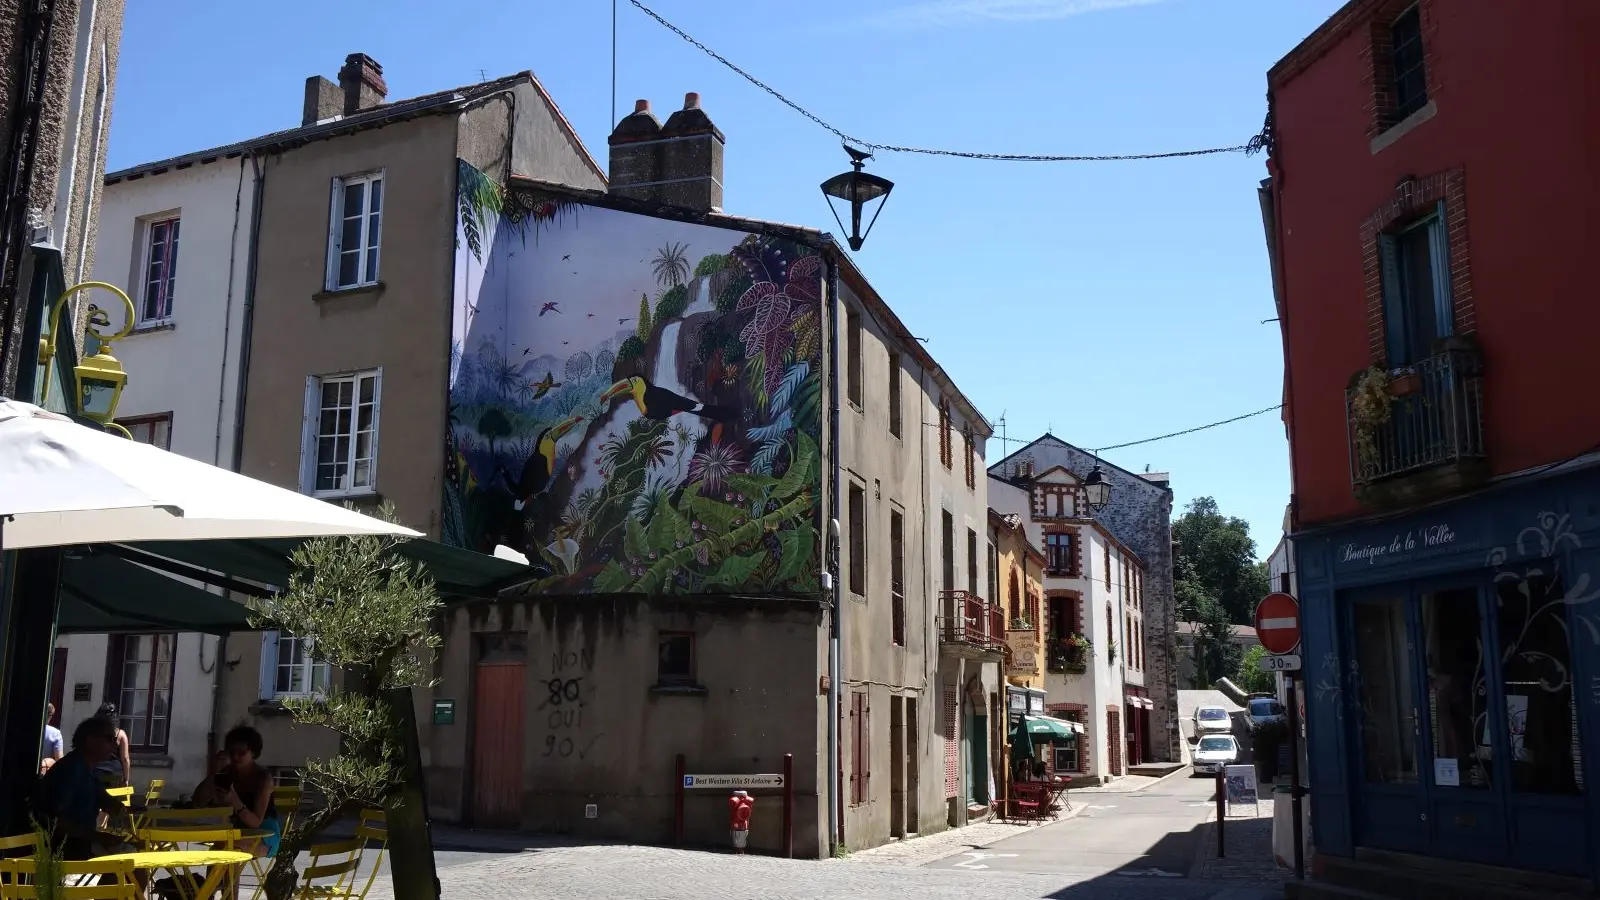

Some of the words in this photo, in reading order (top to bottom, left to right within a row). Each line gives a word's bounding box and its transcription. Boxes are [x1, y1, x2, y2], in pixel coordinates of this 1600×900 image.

[1338, 543, 1386, 564] Boutique
[1389, 533, 1401, 553] de
[1404, 530, 1415, 550] la
[1418, 523, 1455, 547] Vallée
[551, 648, 593, 674] NON
[1270, 658, 1283, 669] 30
[547, 677, 580, 705] 80
[541, 735, 574, 759] 90
[695, 777, 707, 785] Best
[709, 776, 731, 785] Western
[731, 776, 743, 785] Villa
[744, 776, 750, 785] St
[750, 776, 771, 785] Antoine
